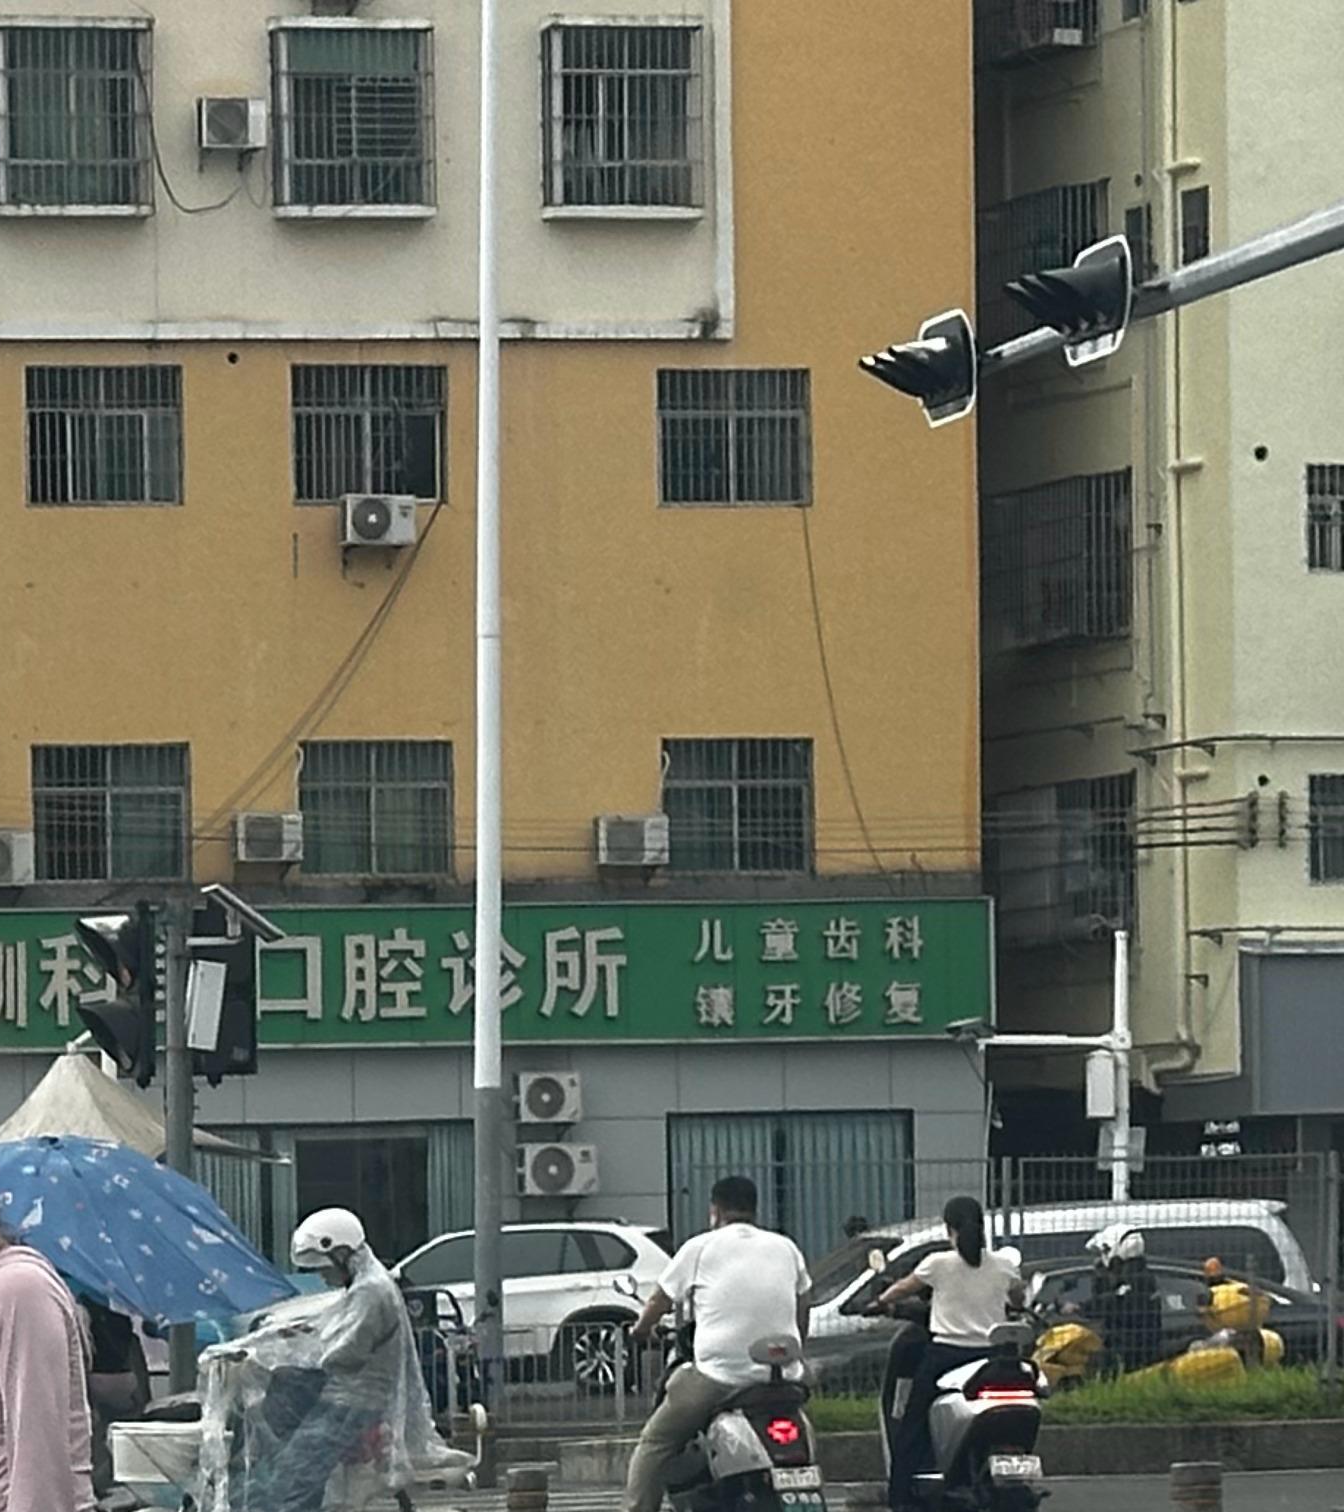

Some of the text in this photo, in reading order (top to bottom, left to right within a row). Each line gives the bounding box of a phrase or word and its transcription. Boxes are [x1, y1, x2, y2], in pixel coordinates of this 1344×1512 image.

[692, 915, 925, 963] 儿童齿科
[695, 980, 925, 1027] 镶牙修复
